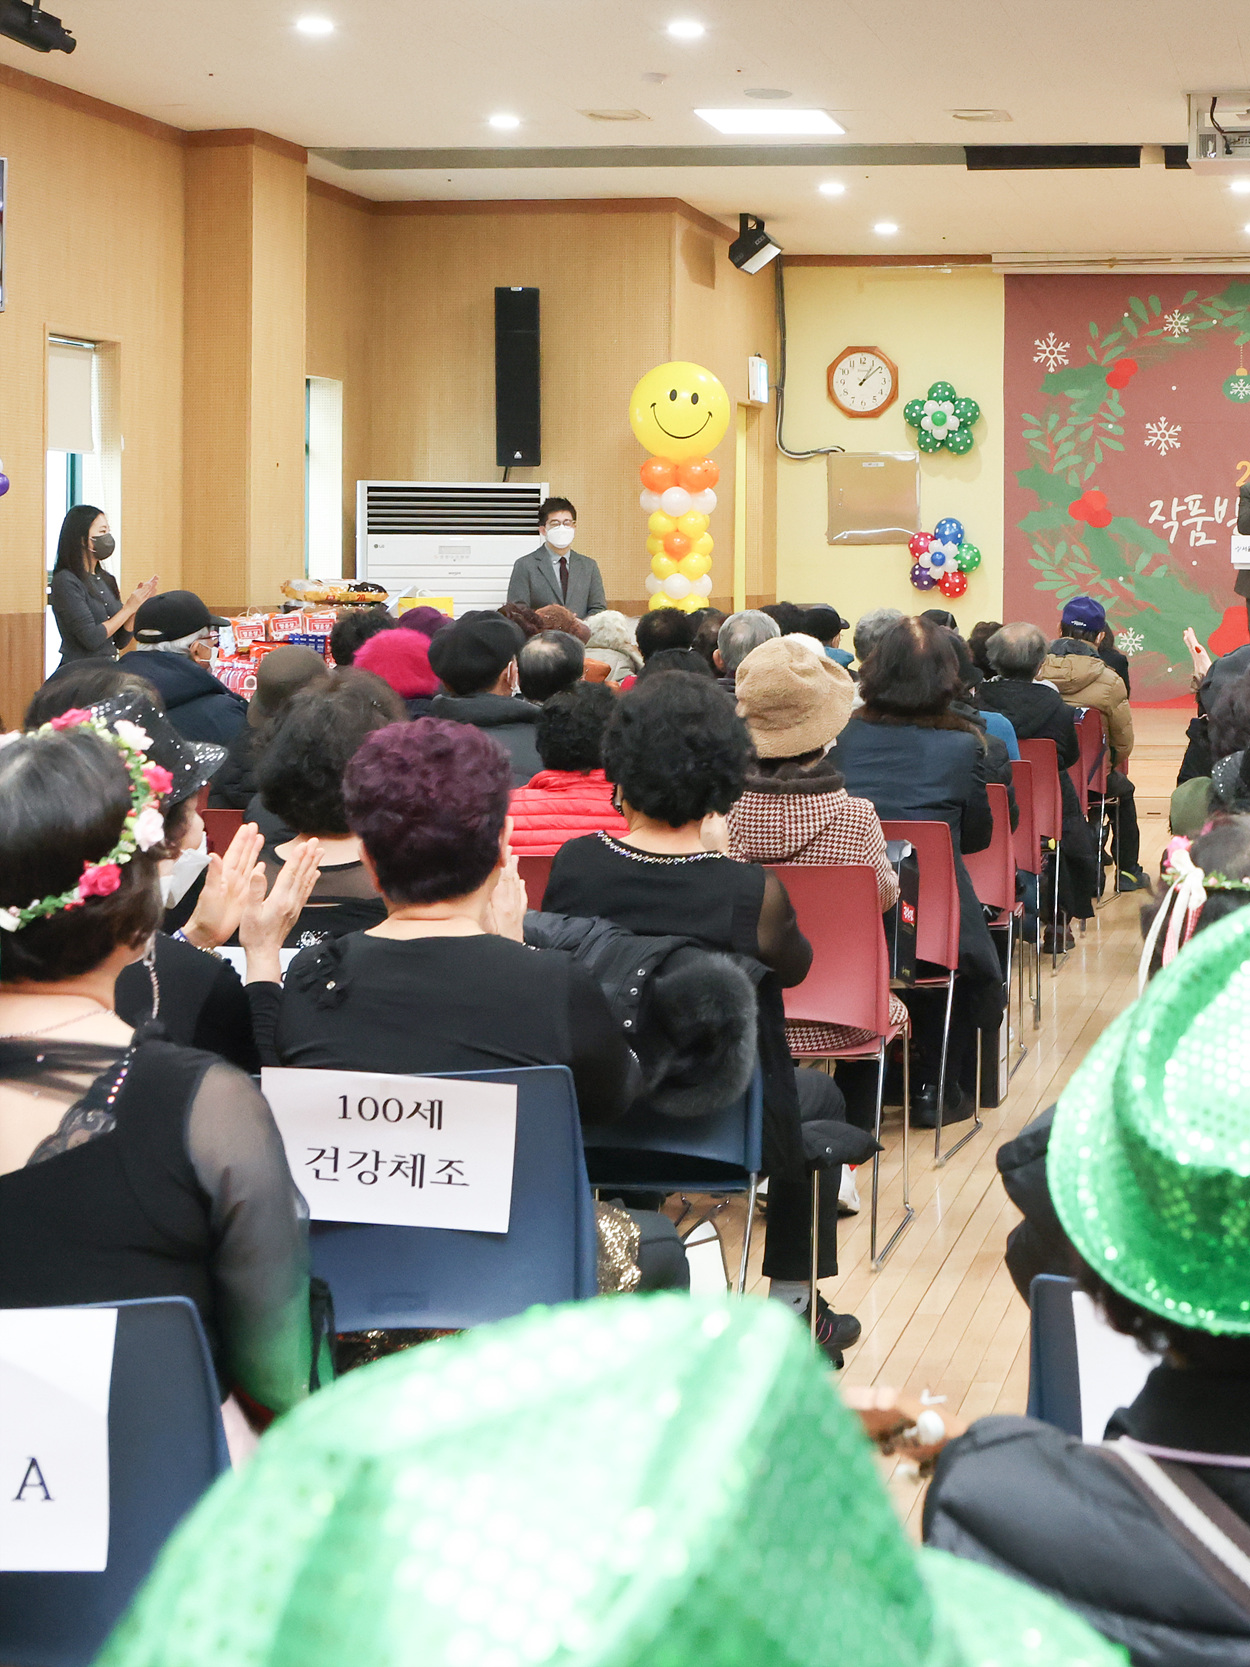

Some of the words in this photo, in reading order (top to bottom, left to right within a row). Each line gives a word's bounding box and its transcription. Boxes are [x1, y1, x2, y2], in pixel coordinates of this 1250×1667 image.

[859, 356, 867, 365] 12
[841, 368, 850, 376] 10
[839, 378, 846, 386] 9
[881, 377, 887, 386] 3
[337, 1094, 444, 1131] 100세
[304, 1145, 470, 1189] 건강체조
[11, 1456, 55, 1502] A
